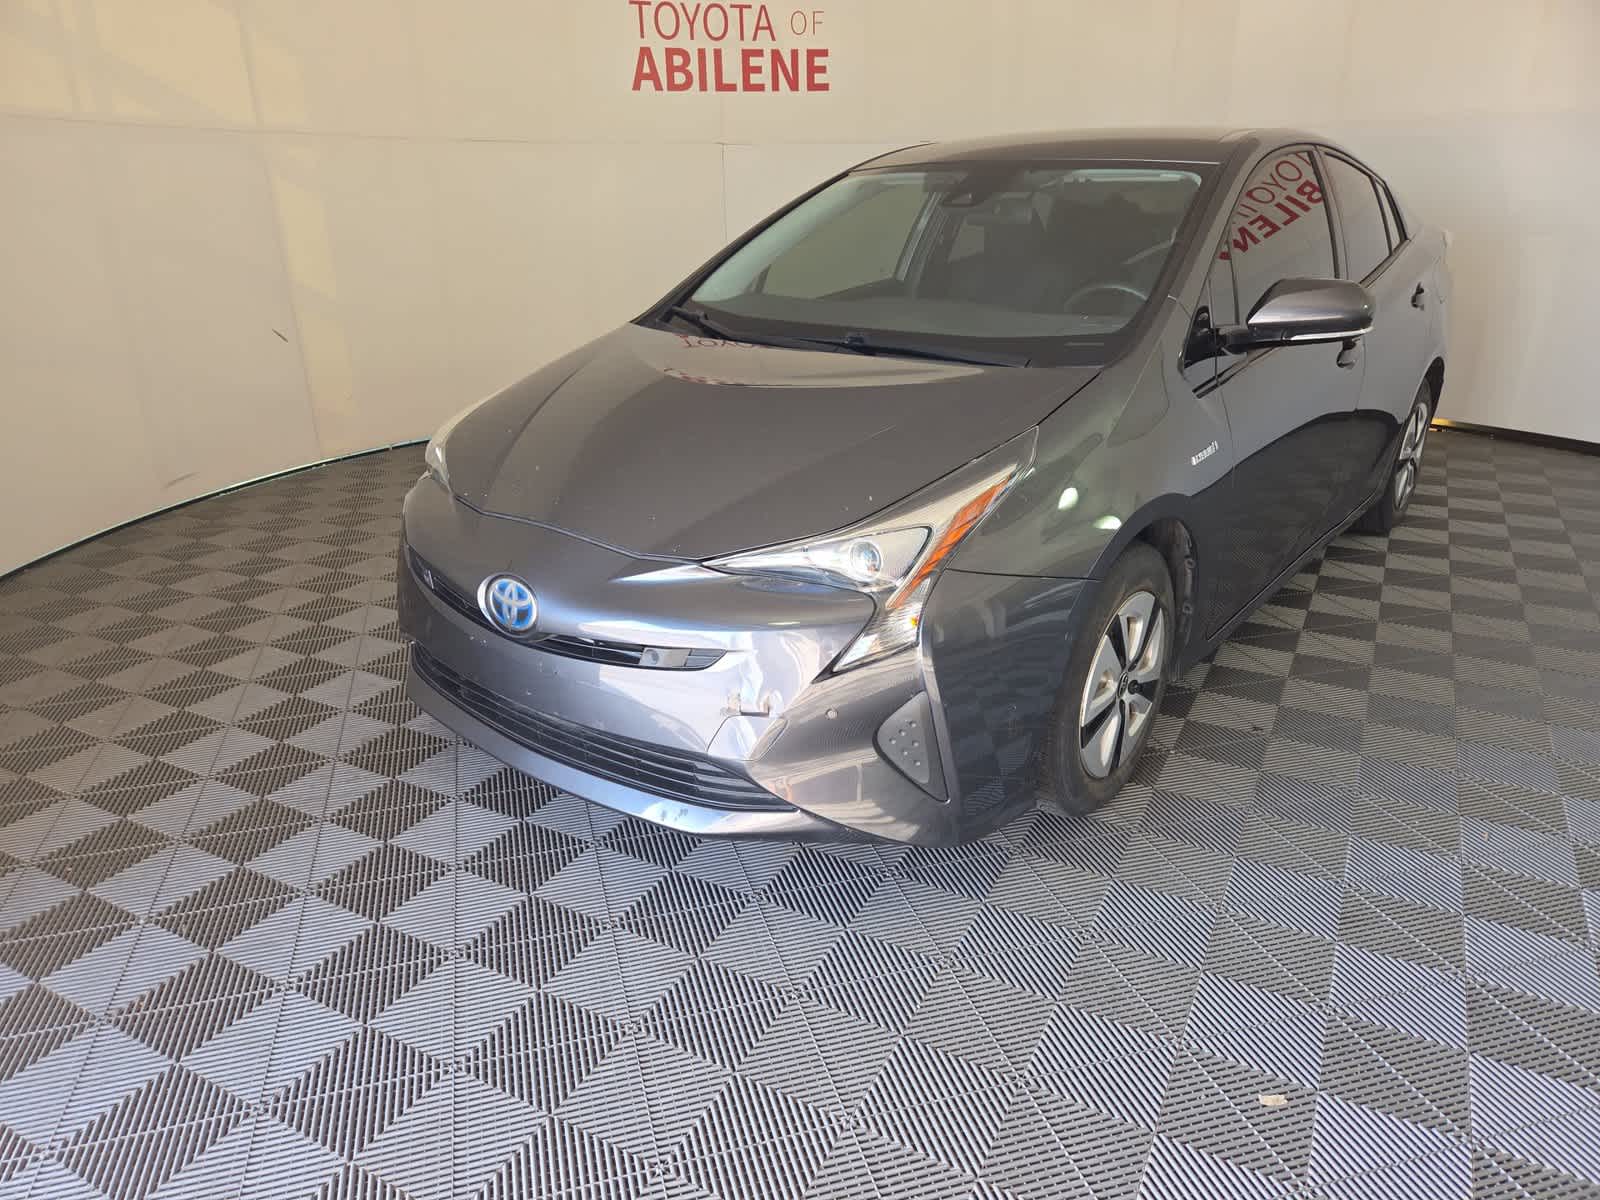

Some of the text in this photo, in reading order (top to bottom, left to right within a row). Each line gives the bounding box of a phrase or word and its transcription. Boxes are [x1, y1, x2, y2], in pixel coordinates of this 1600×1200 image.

[629, 0, 825, 41] TOYOTA OF
[632, 46, 830, 92] ABILENE
